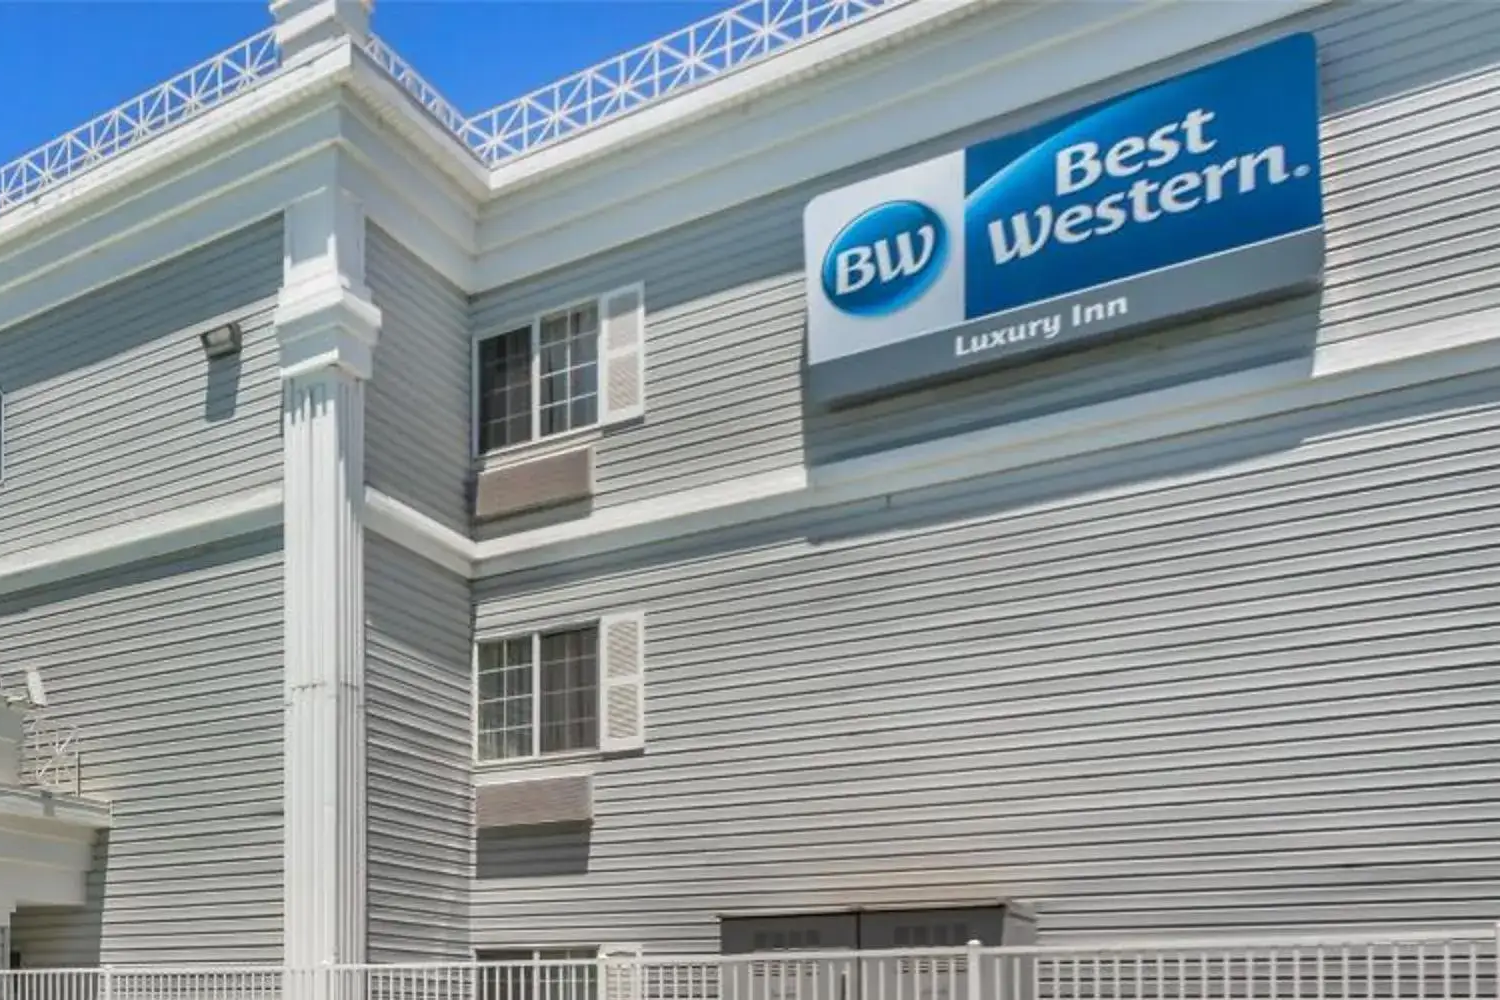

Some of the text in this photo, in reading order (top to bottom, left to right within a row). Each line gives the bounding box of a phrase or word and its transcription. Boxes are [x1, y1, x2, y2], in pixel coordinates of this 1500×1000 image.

[1055, 108, 1218, 196] Best
[834, 224, 935, 296] BW
[955, 297, 1128, 356] Luxury Inn
